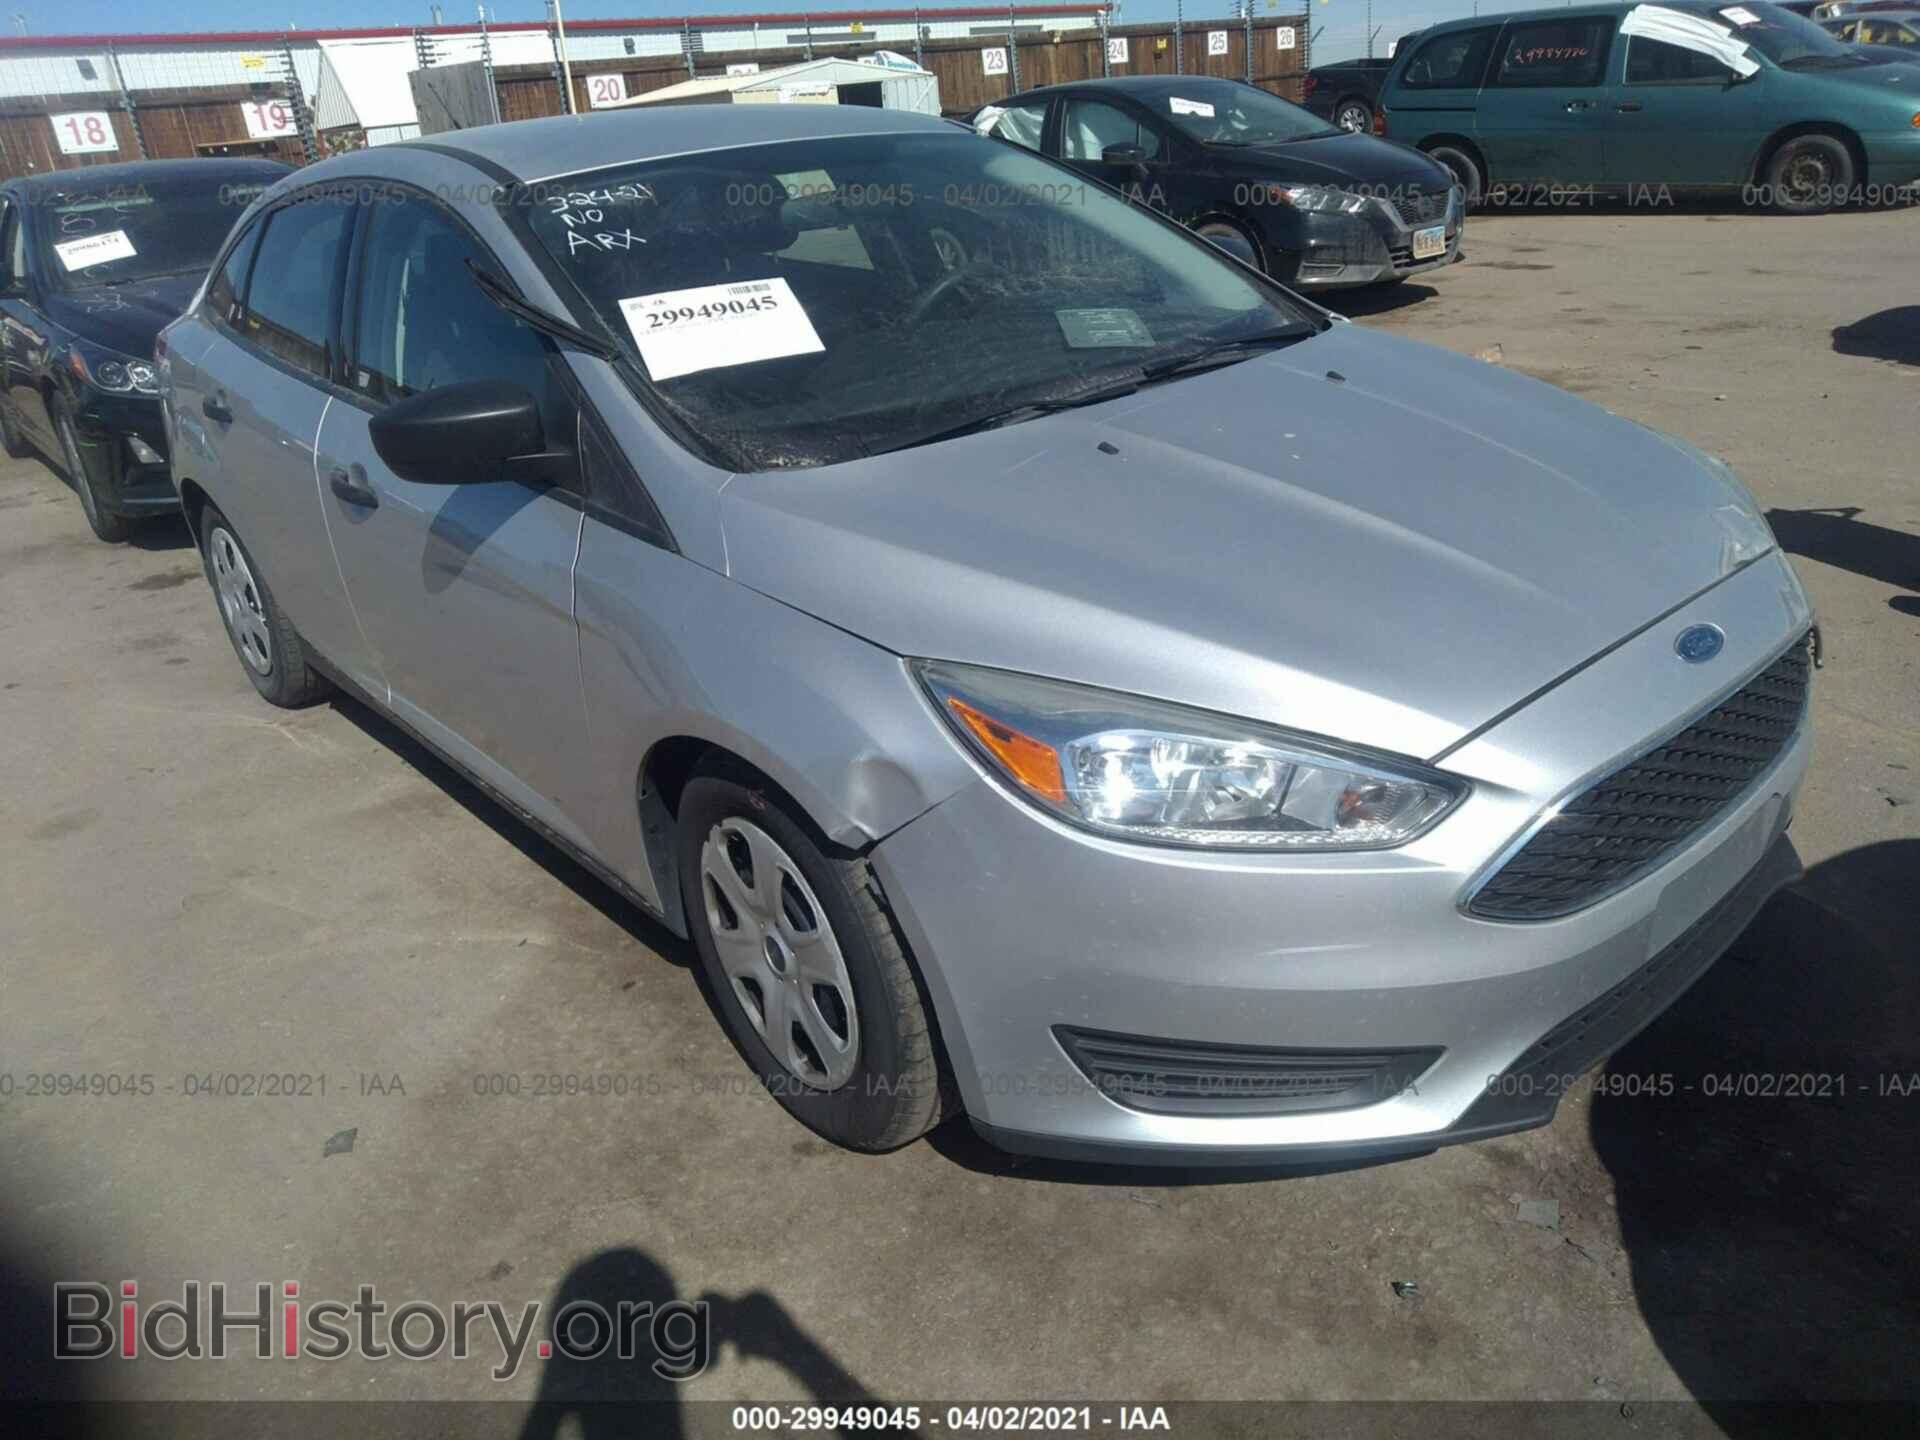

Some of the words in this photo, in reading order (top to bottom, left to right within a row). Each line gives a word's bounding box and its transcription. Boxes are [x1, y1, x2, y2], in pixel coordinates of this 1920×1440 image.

[1210, 33, 1225, 51] 25
[1279, 29, 1294, 45] 26
[1109, 40, 1125, 58] 24
[986, 51, 1005, 70] 23
[593, 77, 621, 102] 20
[252, 103, 289, 132] 19
[64, 116, 107, 147] 18
[561, 208, 604, 228] NO
[567, 228, 647, 256] ARX
[645, 295, 779, 329] 29949045
